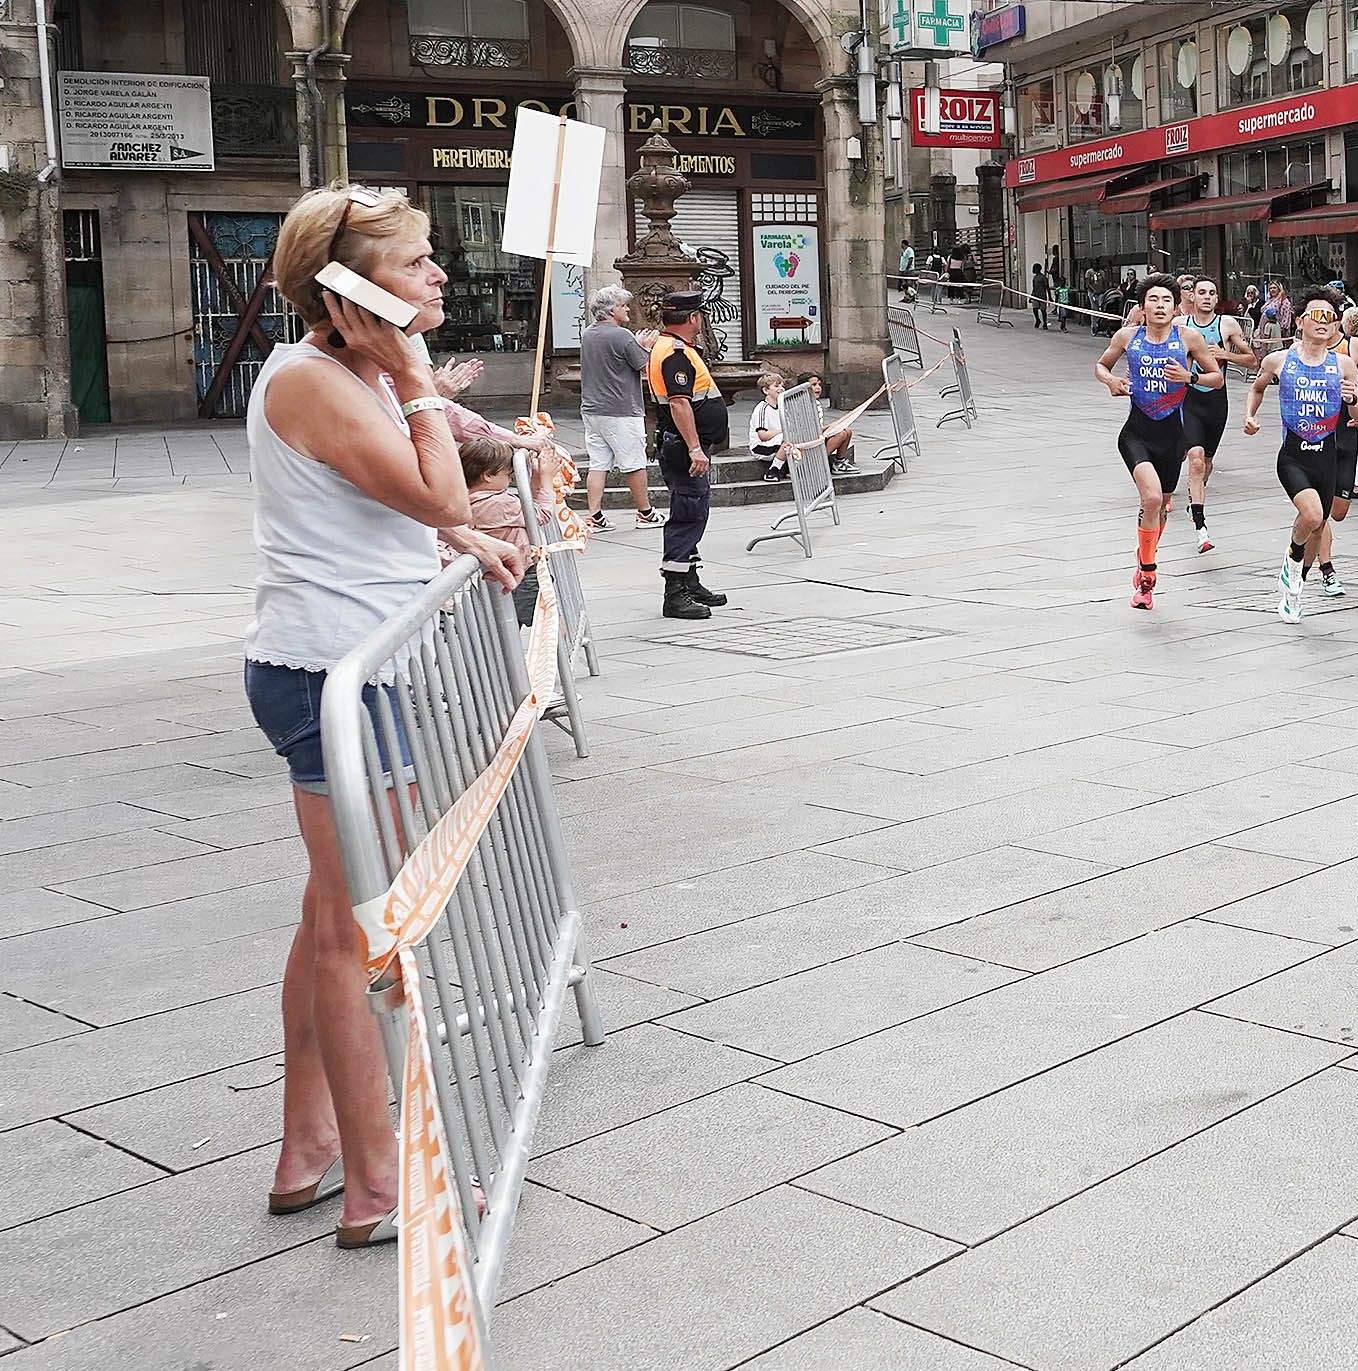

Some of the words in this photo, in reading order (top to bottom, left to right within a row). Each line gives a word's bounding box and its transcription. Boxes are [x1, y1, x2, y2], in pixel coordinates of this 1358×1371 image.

[921, 16, 960, 27] FARMACIA
[111, 79, 145, 87] INTERIOR
[108, 101, 141, 109] AGUILAR
[108, 112, 142, 120] AGUILAR
[1238, 102, 1315, 135] supermercado
[949, 133, 993, 142] multicentro
[1166, 126, 1188, 146] FROIZ
[109, 143, 162, 151] SANCHEZ
[109, 152, 158, 162] ALVAREZ
[1070, 143, 1123, 169] supermercado
[760, 240, 792, 249] Varela
[1139, 366, 1165, 379] OKAD
[1143, 379, 1168, 393] JPN
[1294, 388, 1328, 403] TANAKA
[1297, 403, 1325, 418] JPN
